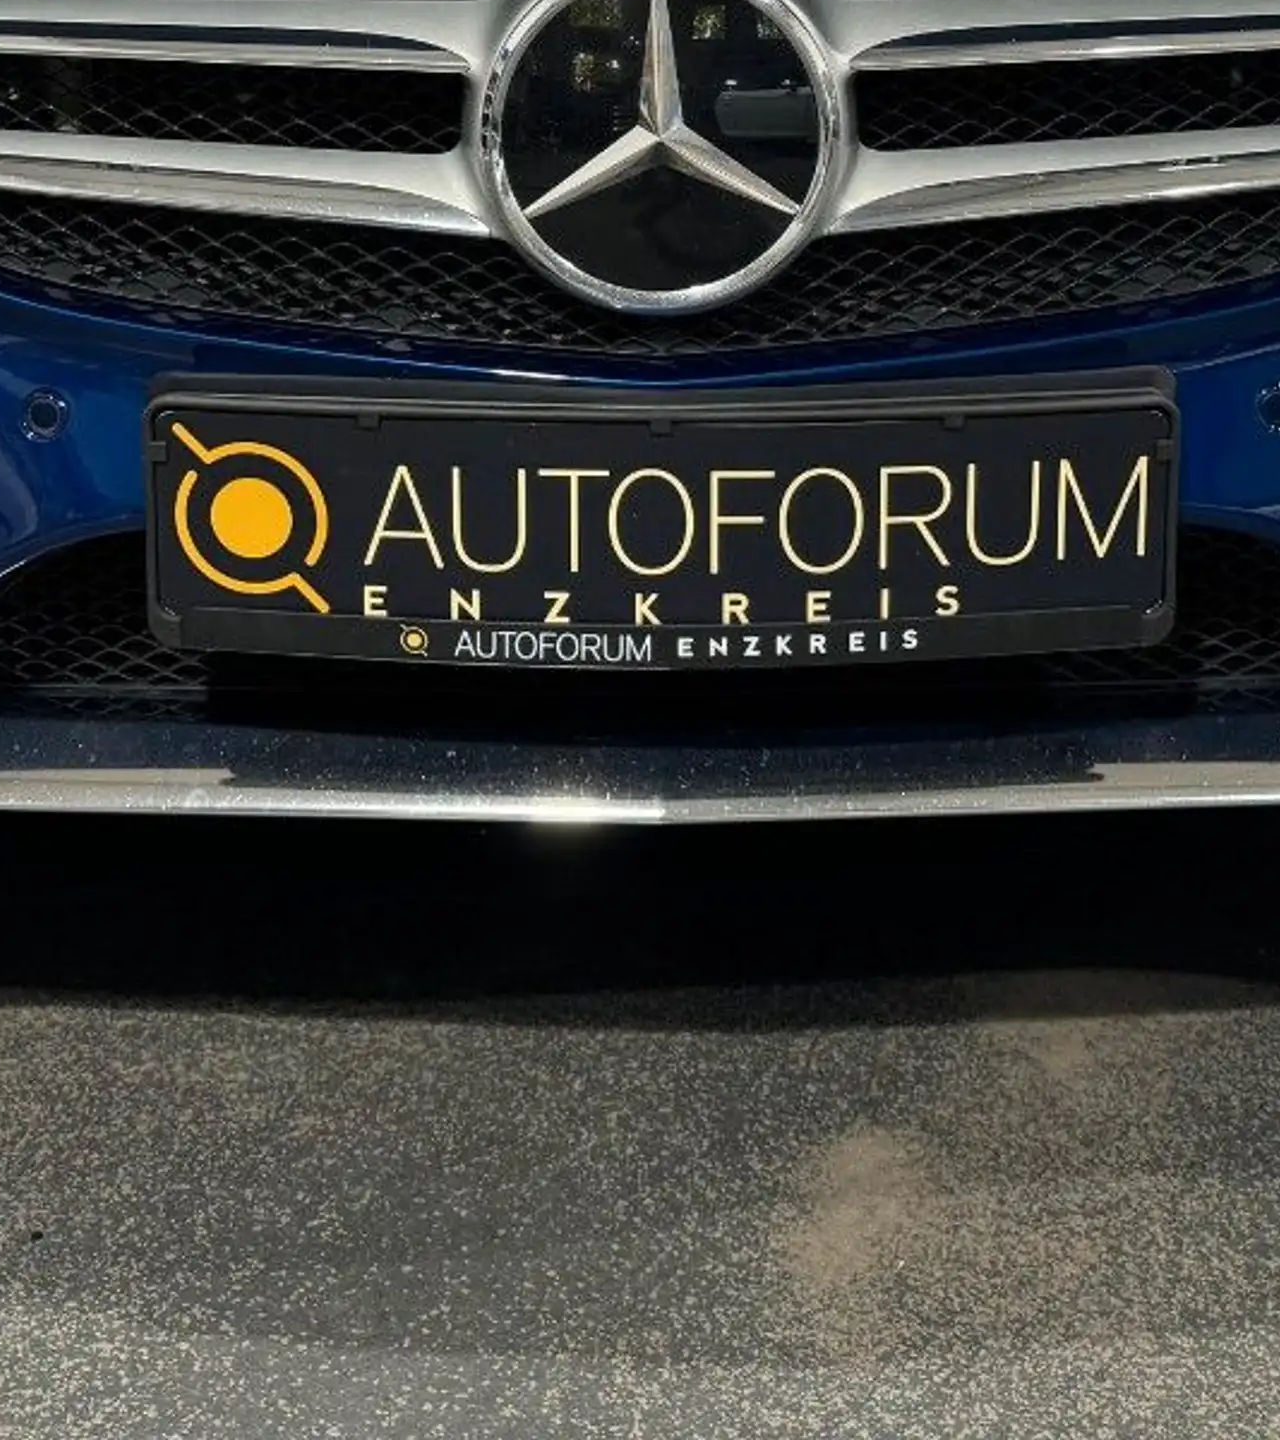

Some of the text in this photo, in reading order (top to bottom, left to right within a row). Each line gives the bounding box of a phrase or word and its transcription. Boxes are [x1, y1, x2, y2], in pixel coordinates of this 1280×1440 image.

[364, 456, 1149, 576] AUTOFORUM
[363, 585, 960, 626] ENZKREIS
[453, 629, 919, 662] AUTOFORUM ENZKREIS
